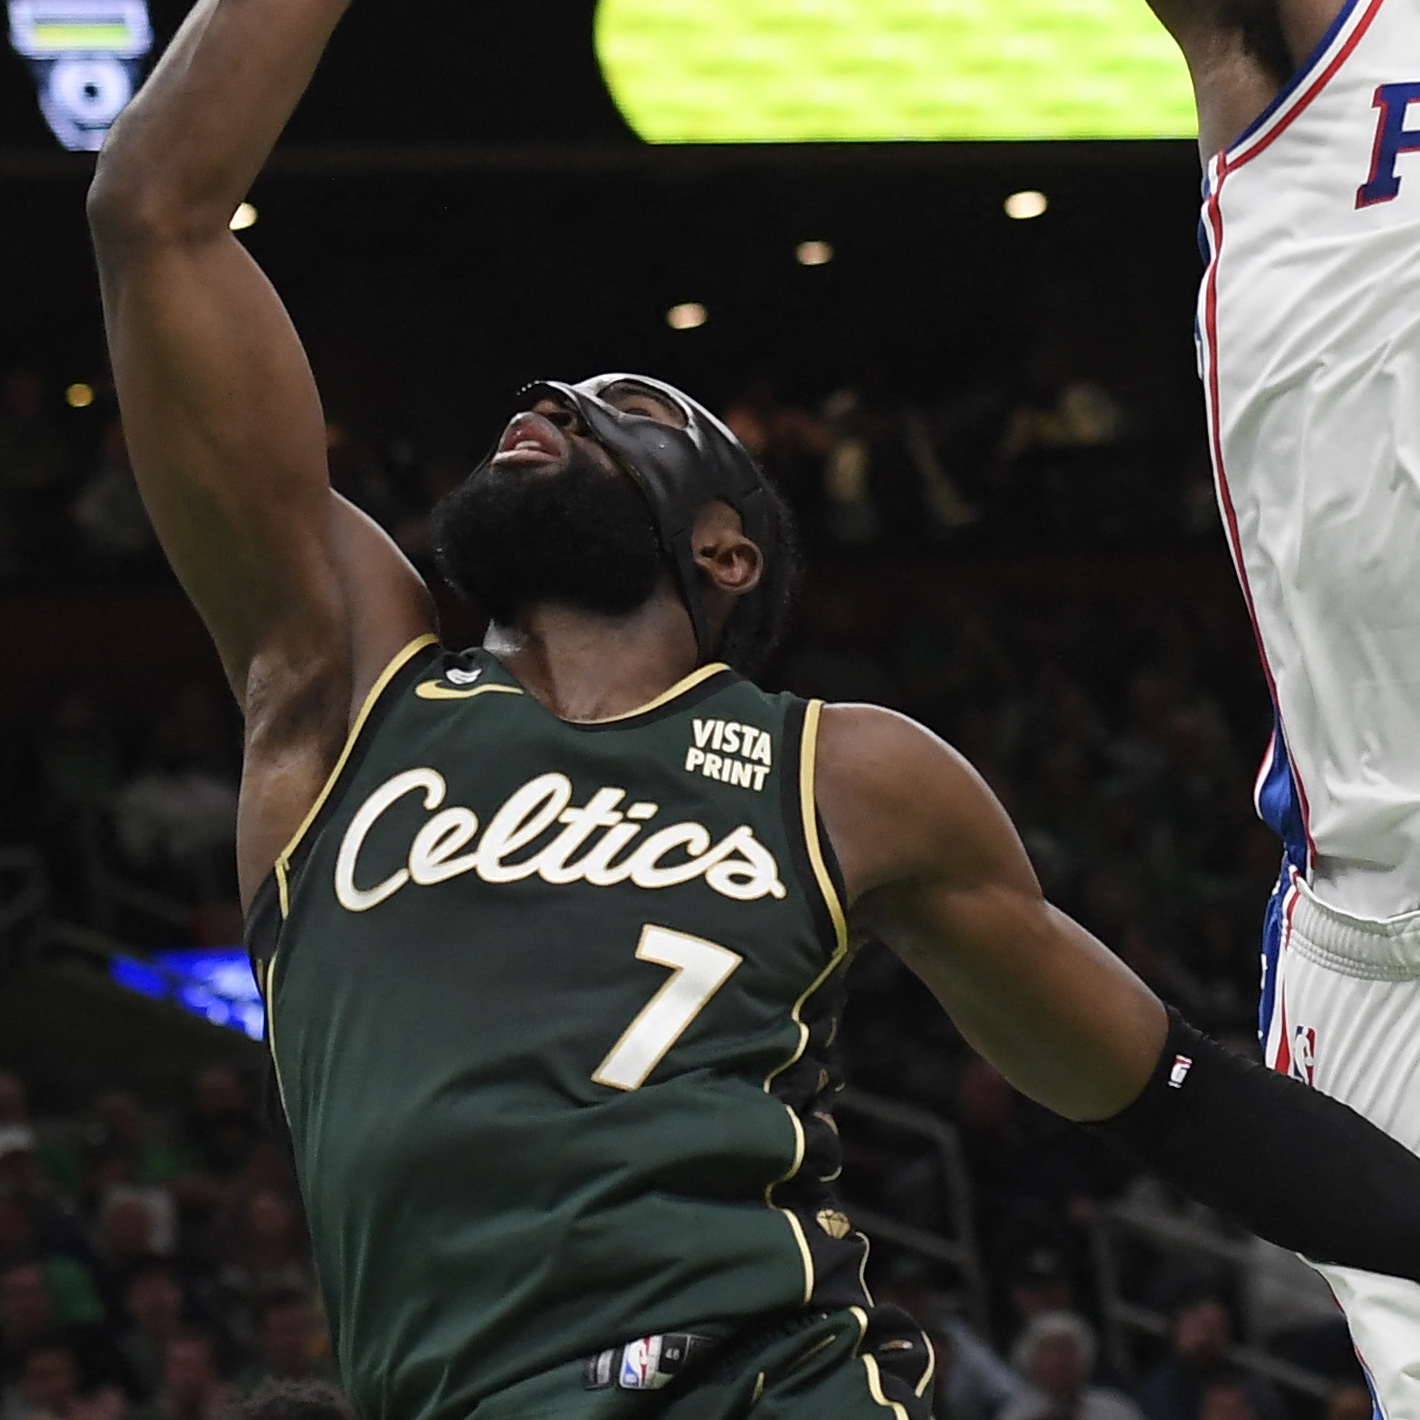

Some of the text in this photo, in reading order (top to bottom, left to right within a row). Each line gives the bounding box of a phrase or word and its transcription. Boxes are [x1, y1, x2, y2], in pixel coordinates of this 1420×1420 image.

[684, 746, 771, 793] PRINT
[691, 718, 773, 767] VISTA
[335, 766, 786, 912] Celtics
[590, 923, 743, 1092] 7
